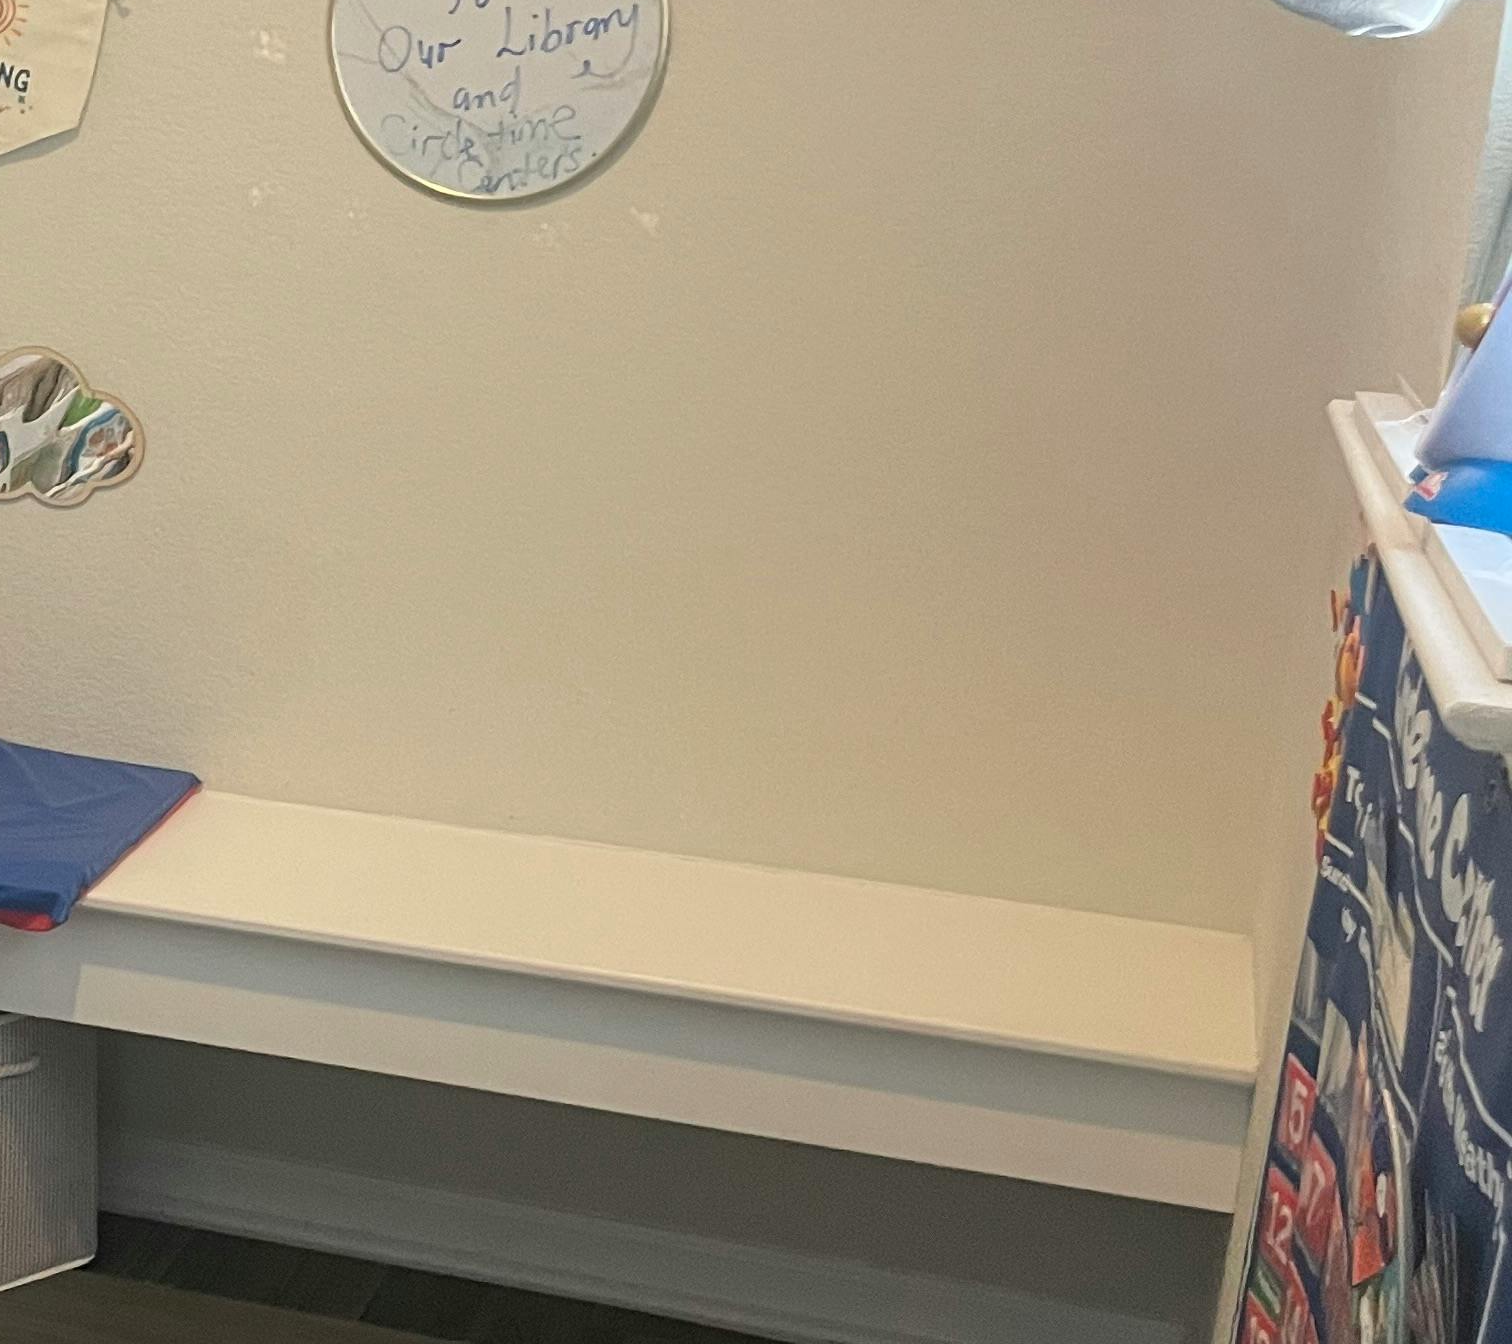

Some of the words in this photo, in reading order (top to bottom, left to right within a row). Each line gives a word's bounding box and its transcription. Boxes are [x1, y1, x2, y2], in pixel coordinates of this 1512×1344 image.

[378, 25, 462, 73] Our
[495, 2, 640, 80] Library
[452, 64, 522, 119] and
[1288, 1078, 1305, 1145] 5
[1266, 1190, 1294, 1267] 12
